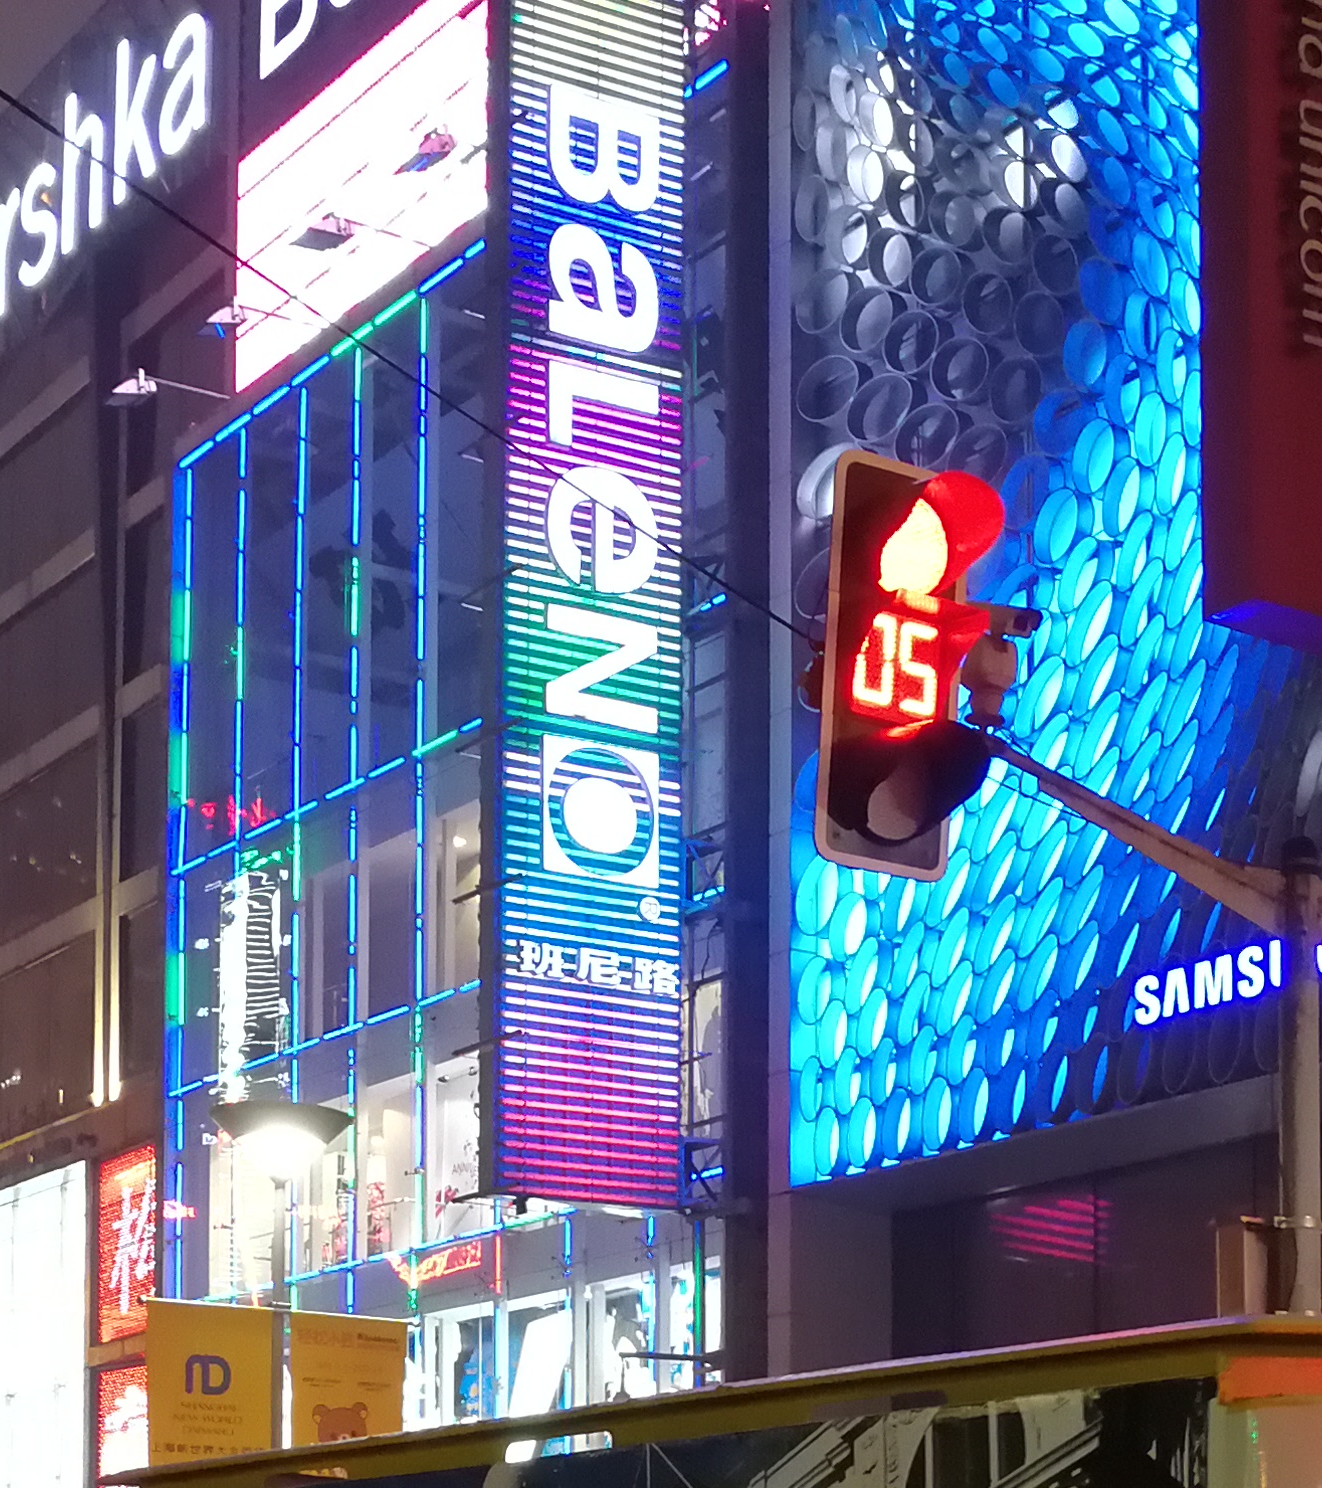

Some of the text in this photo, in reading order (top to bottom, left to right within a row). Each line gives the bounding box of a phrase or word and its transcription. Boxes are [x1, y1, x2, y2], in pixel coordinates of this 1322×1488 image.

[852, 611, 939, 719] 05
[520, 940, 680, 998] 班尼路
